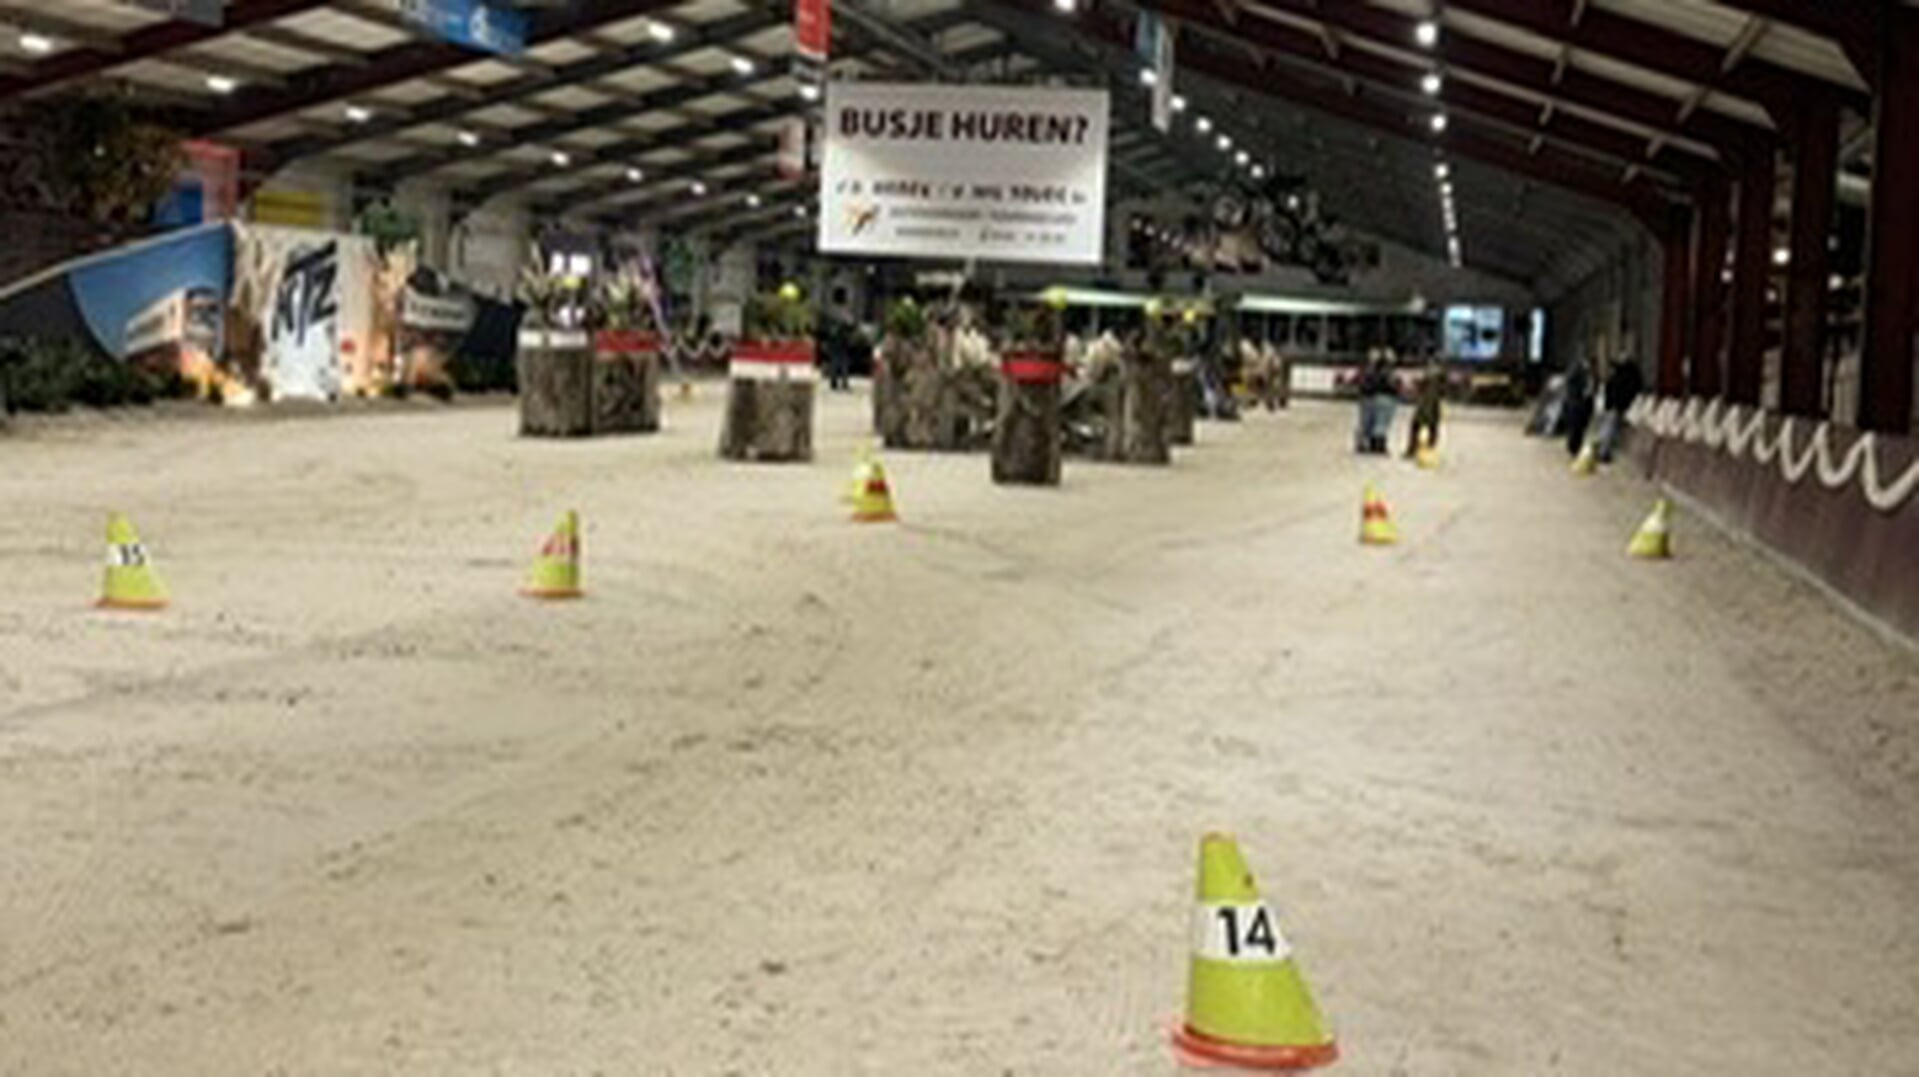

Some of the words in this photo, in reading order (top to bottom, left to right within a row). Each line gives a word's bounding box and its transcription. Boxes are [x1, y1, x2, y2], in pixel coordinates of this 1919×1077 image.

[840, 107, 943, 140] BUSJE
[952, 111, 1089, 145] HUREN?
[1217, 905, 1276, 956] 14
